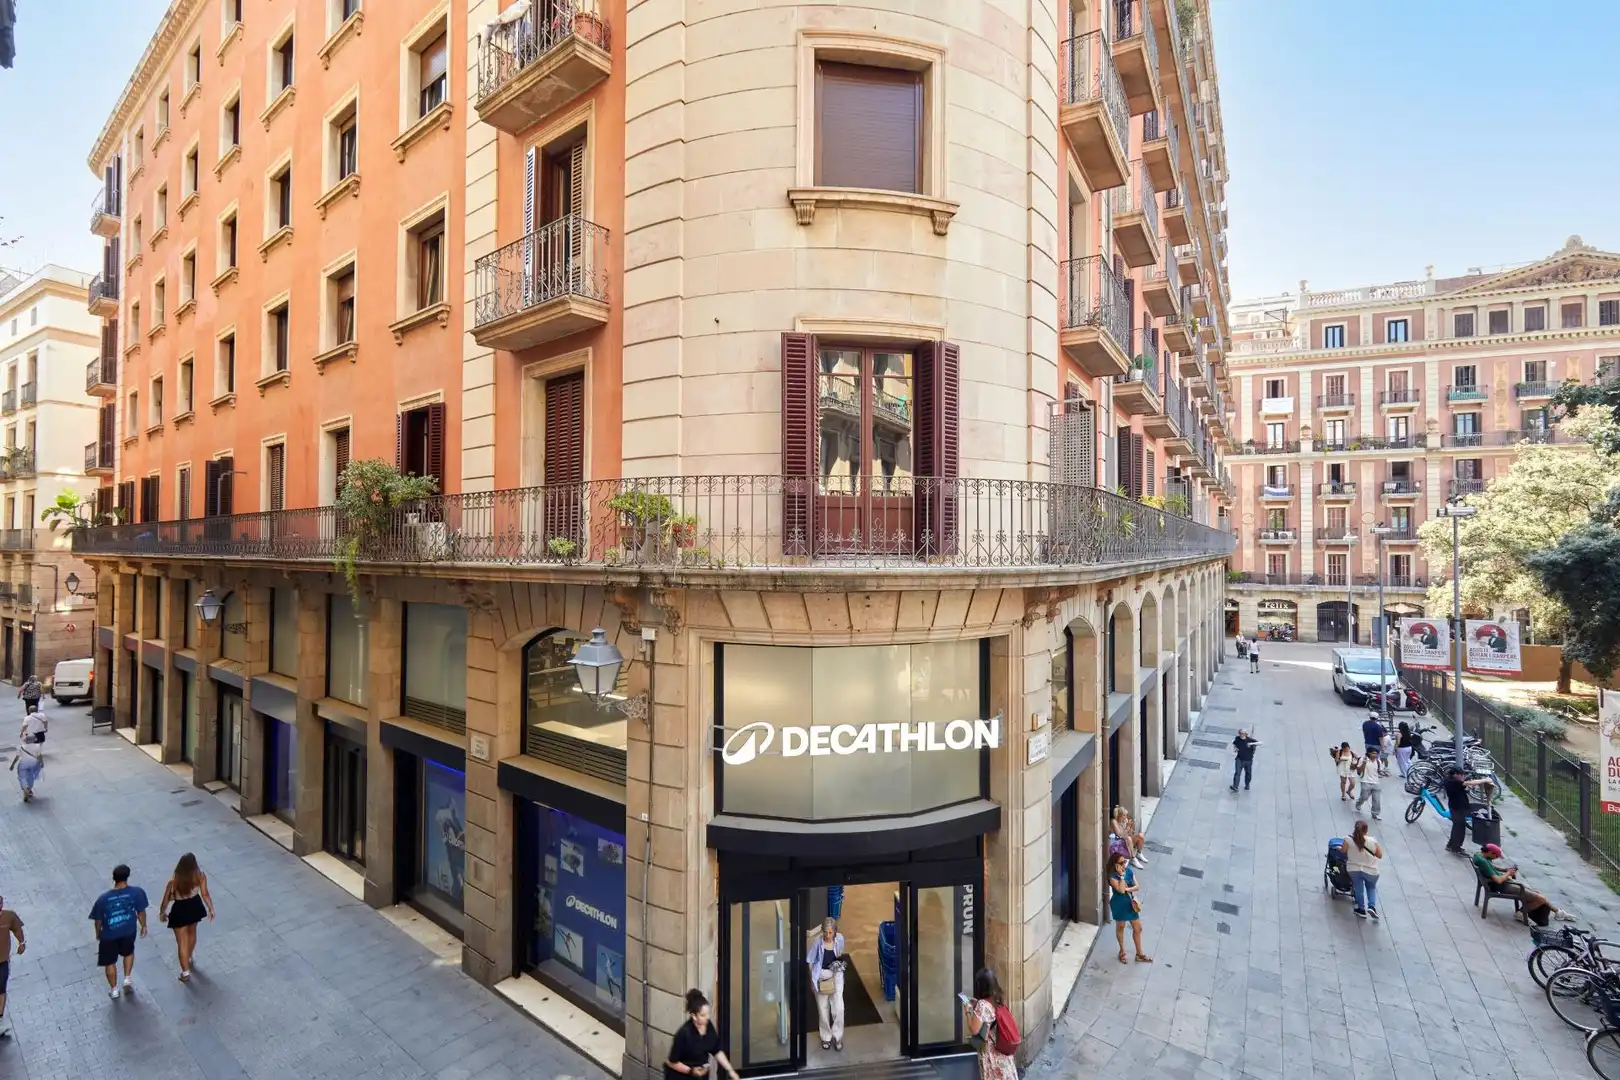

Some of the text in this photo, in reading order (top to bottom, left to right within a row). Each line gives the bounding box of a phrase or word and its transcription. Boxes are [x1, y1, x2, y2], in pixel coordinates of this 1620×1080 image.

[782, 719, 999, 757] DECATHLON
[575, 899, 617, 929] DECATHLON
[963, 884, 973, 934] PRUN
